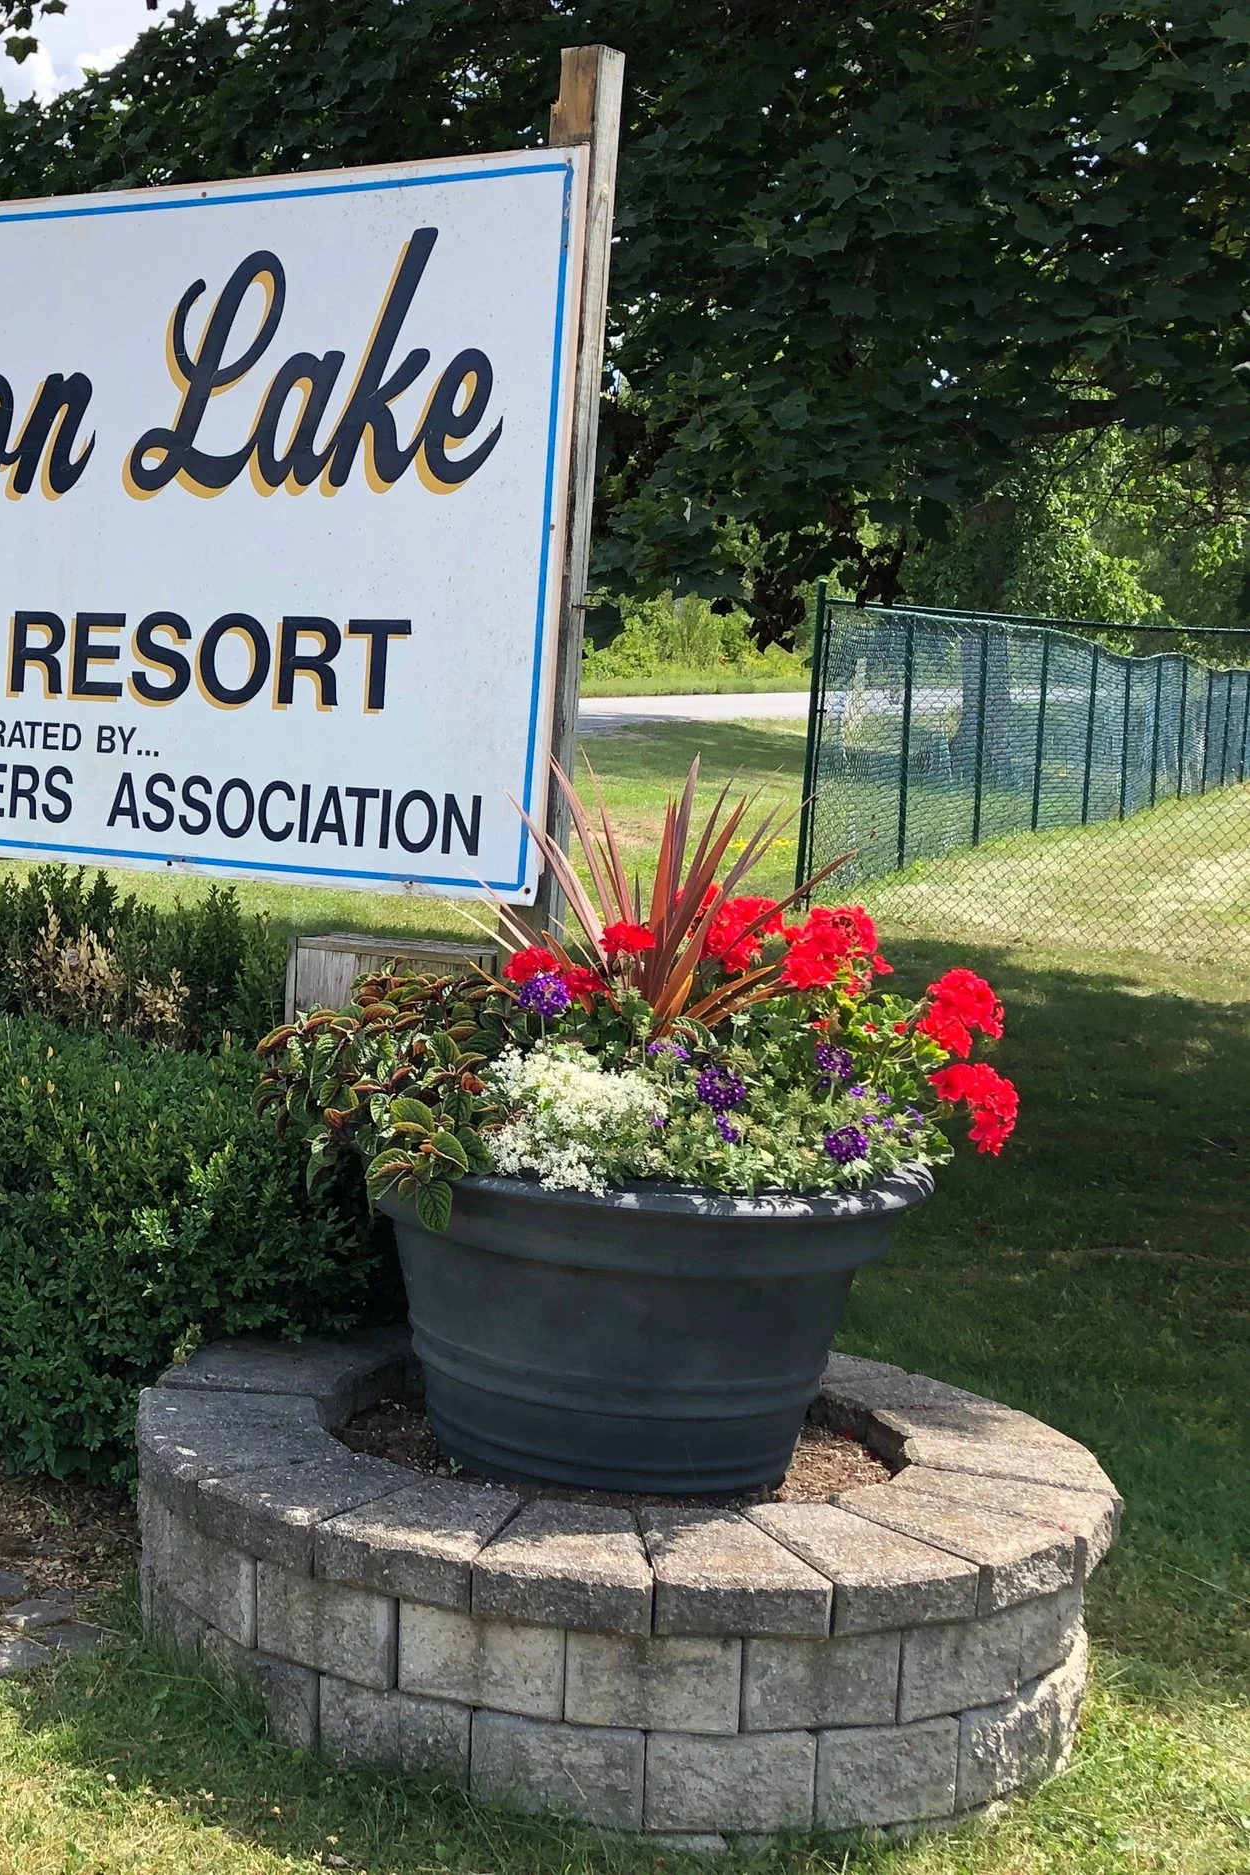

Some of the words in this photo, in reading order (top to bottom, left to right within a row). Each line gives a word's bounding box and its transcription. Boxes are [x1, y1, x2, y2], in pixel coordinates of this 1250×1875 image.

[122, 226, 504, 500] Lake
[7, 610, 412, 714] RESORT
[105, 771, 483, 858] ASSOCIATION
